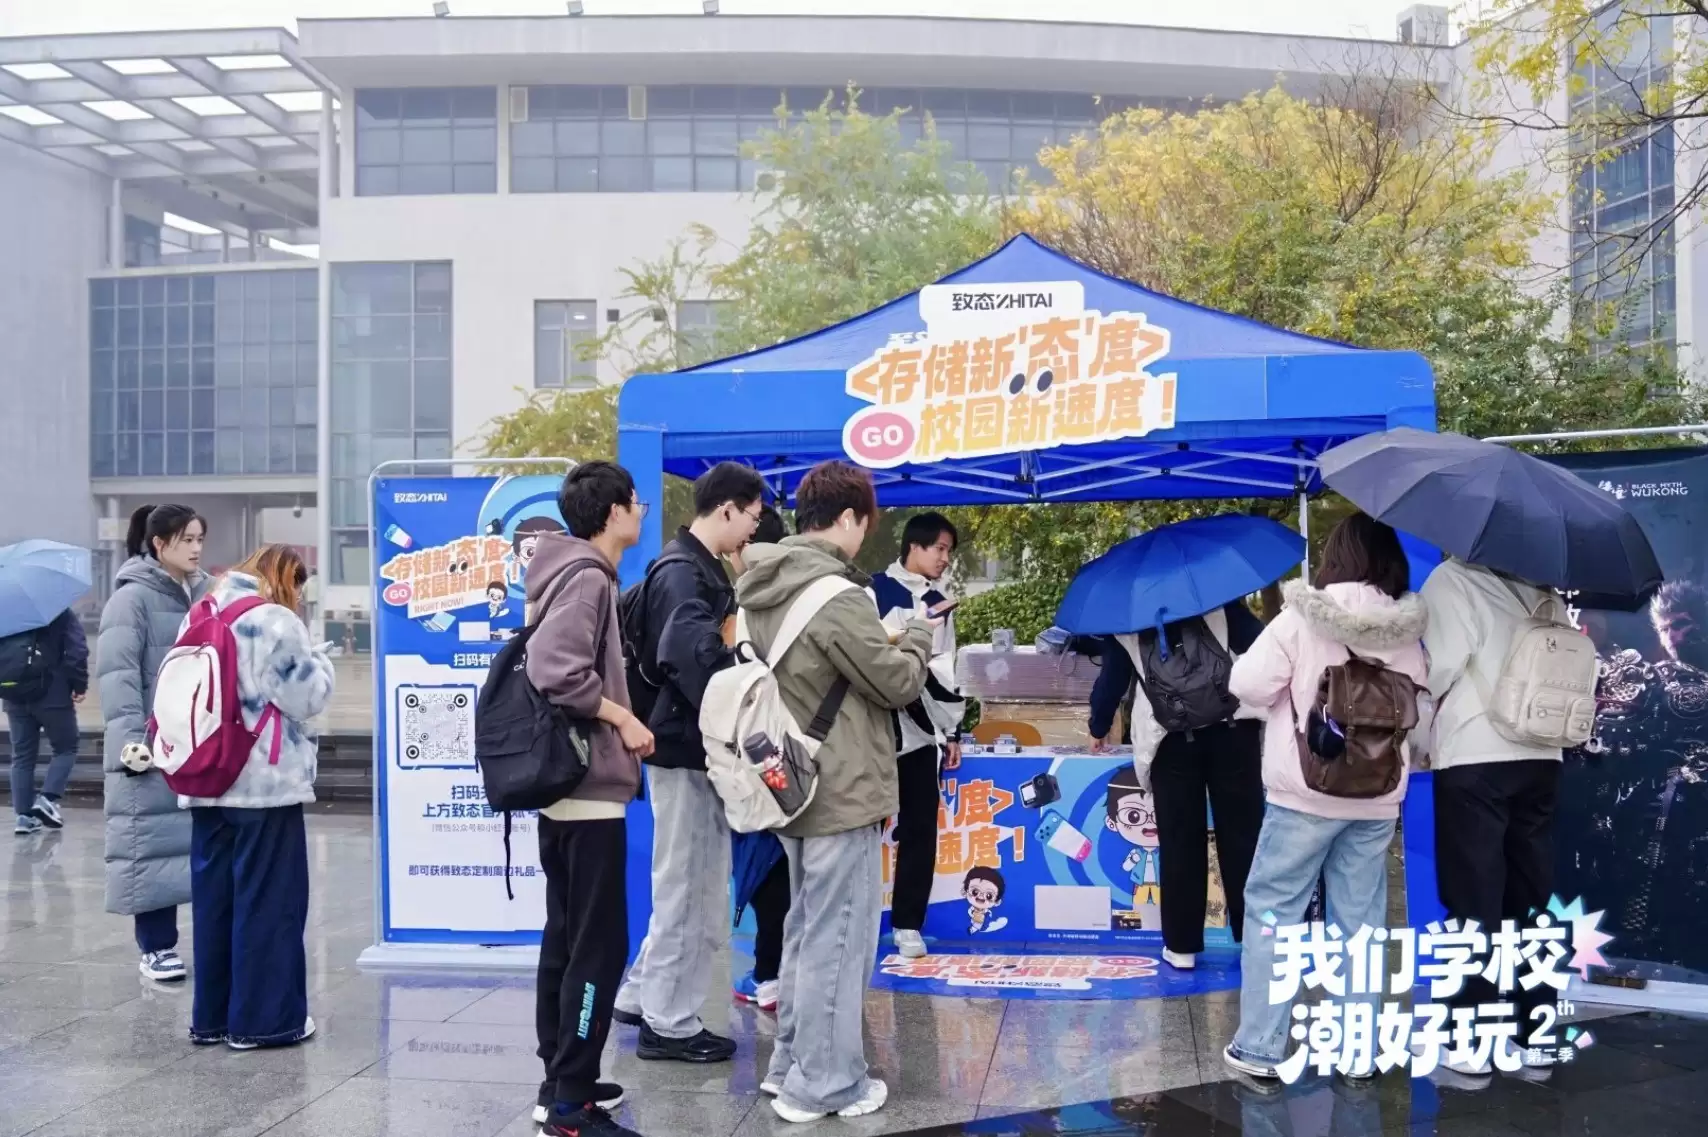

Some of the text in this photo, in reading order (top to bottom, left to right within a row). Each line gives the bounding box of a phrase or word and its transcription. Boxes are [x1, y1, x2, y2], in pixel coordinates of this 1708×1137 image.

[860, 426, 904, 448] GO
[1631, 487, 1689, 498] WUKONG
[453, 652, 497, 667] 扫码有
